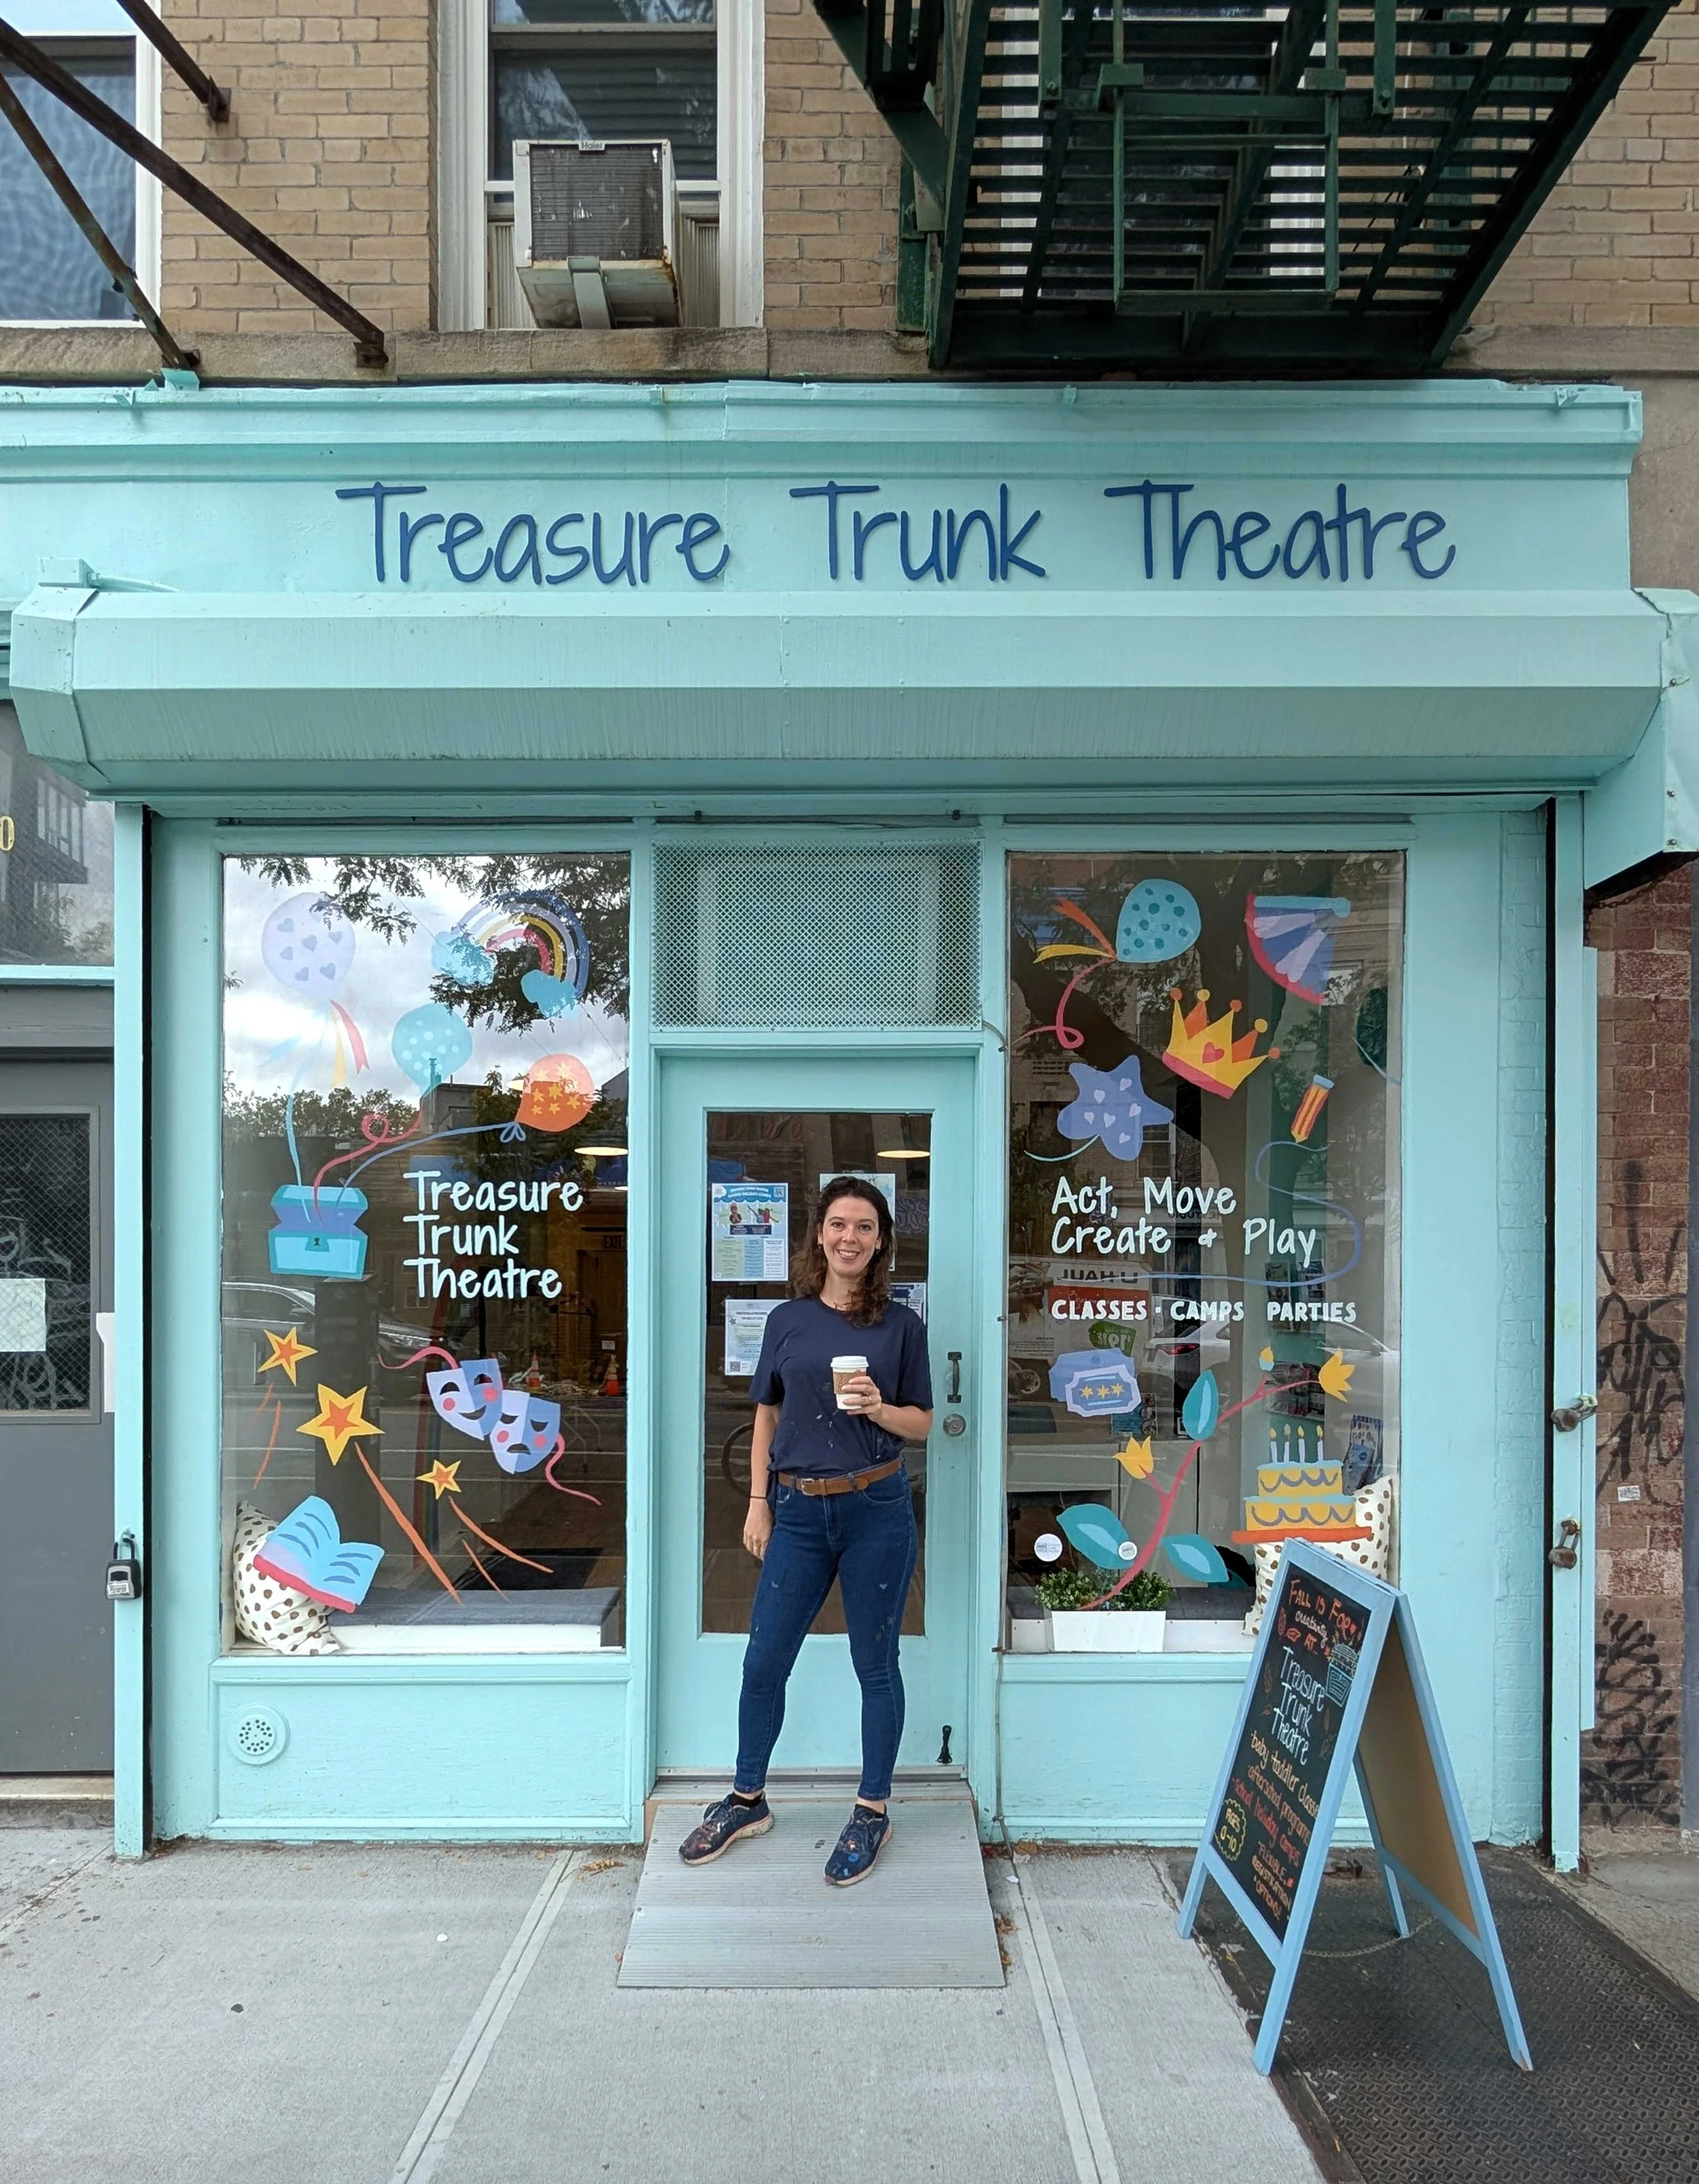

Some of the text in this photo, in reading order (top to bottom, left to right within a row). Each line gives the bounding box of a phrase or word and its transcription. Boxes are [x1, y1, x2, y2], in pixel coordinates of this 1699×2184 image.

[335, 479, 1456, 586] Treasure Trunk Theatre
[403, 1170, 584, 1212] Treasure
[1051, 1176, 1236, 1219] Act, Move
[403, 1214, 519, 1256] Trunk
[1051, 1216, 1172, 1254] Create
[1243, 1218, 1316, 1268] Play
[403, 1257, 563, 1299] Theatre
[1051, 1299, 1356, 1322] CLASSES CAMPS PARTIES
[1295, 1610, 1329, 1649] creativity
[1280, 1646, 1325, 1712] Treasure
[1280, 1682, 1313, 1738] Trunk
[1272, 1707, 1310, 1765] Theatre
[1220, 1825, 1238, 1852] 0-10
